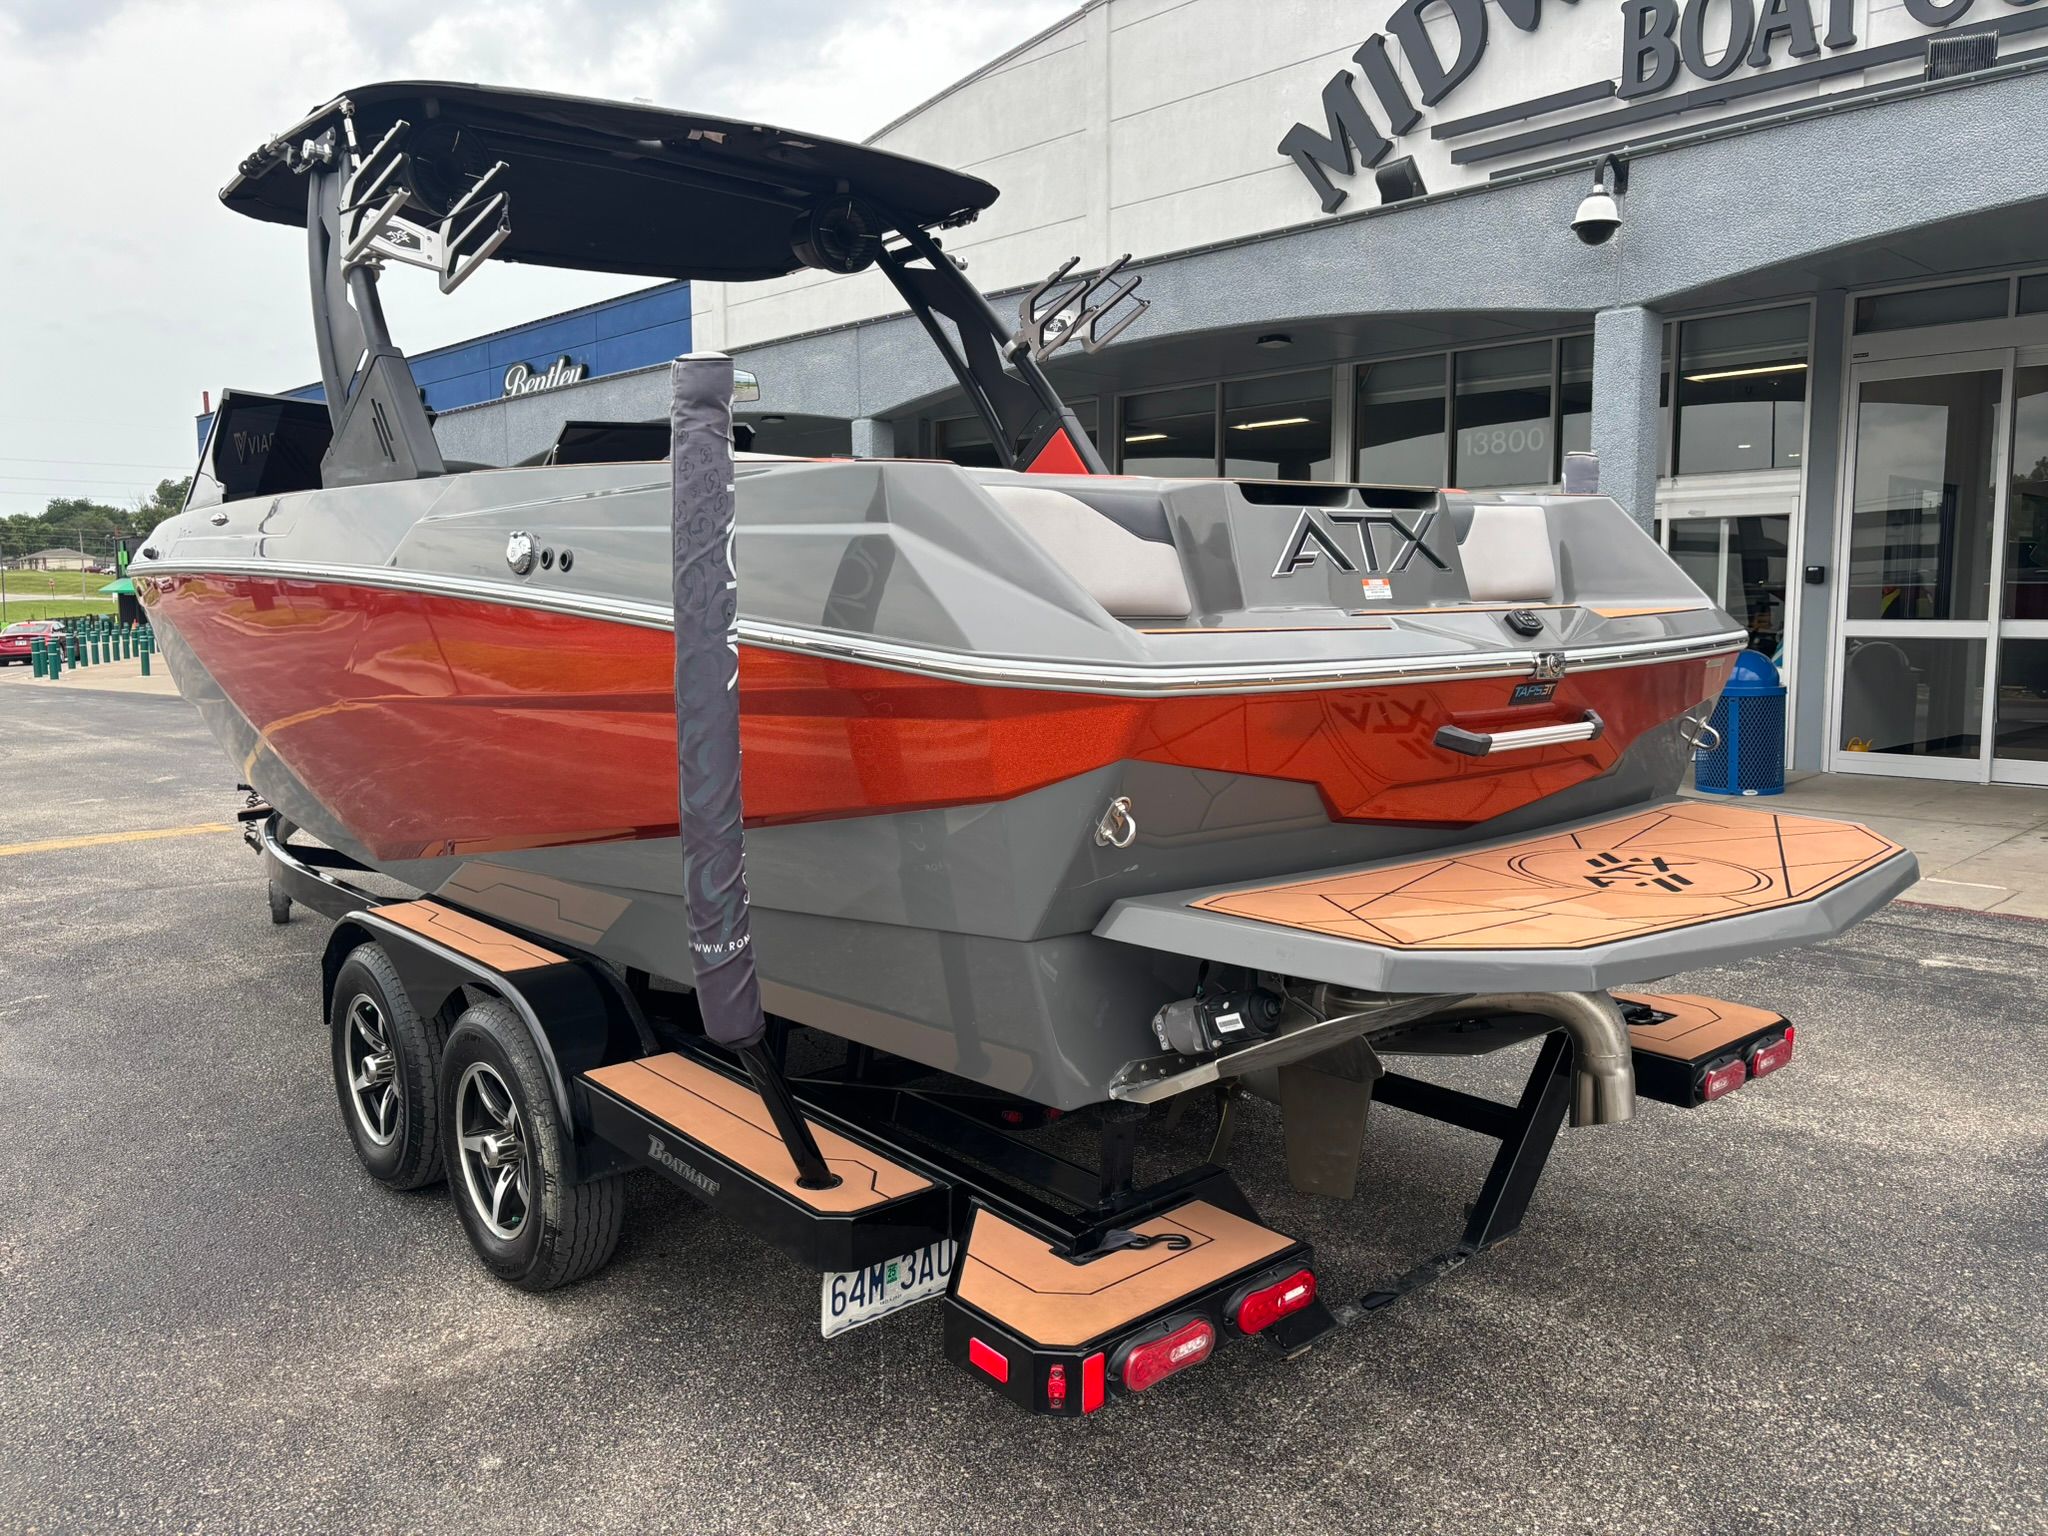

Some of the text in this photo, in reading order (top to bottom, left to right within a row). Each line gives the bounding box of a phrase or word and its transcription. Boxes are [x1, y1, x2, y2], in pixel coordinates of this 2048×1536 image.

[503, 358, 585, 397] Bentley
[1464, 427, 1545, 456] 13800
[1272, 507, 1453, 579] ATX
[831, 1261, 884, 1317] 64M
